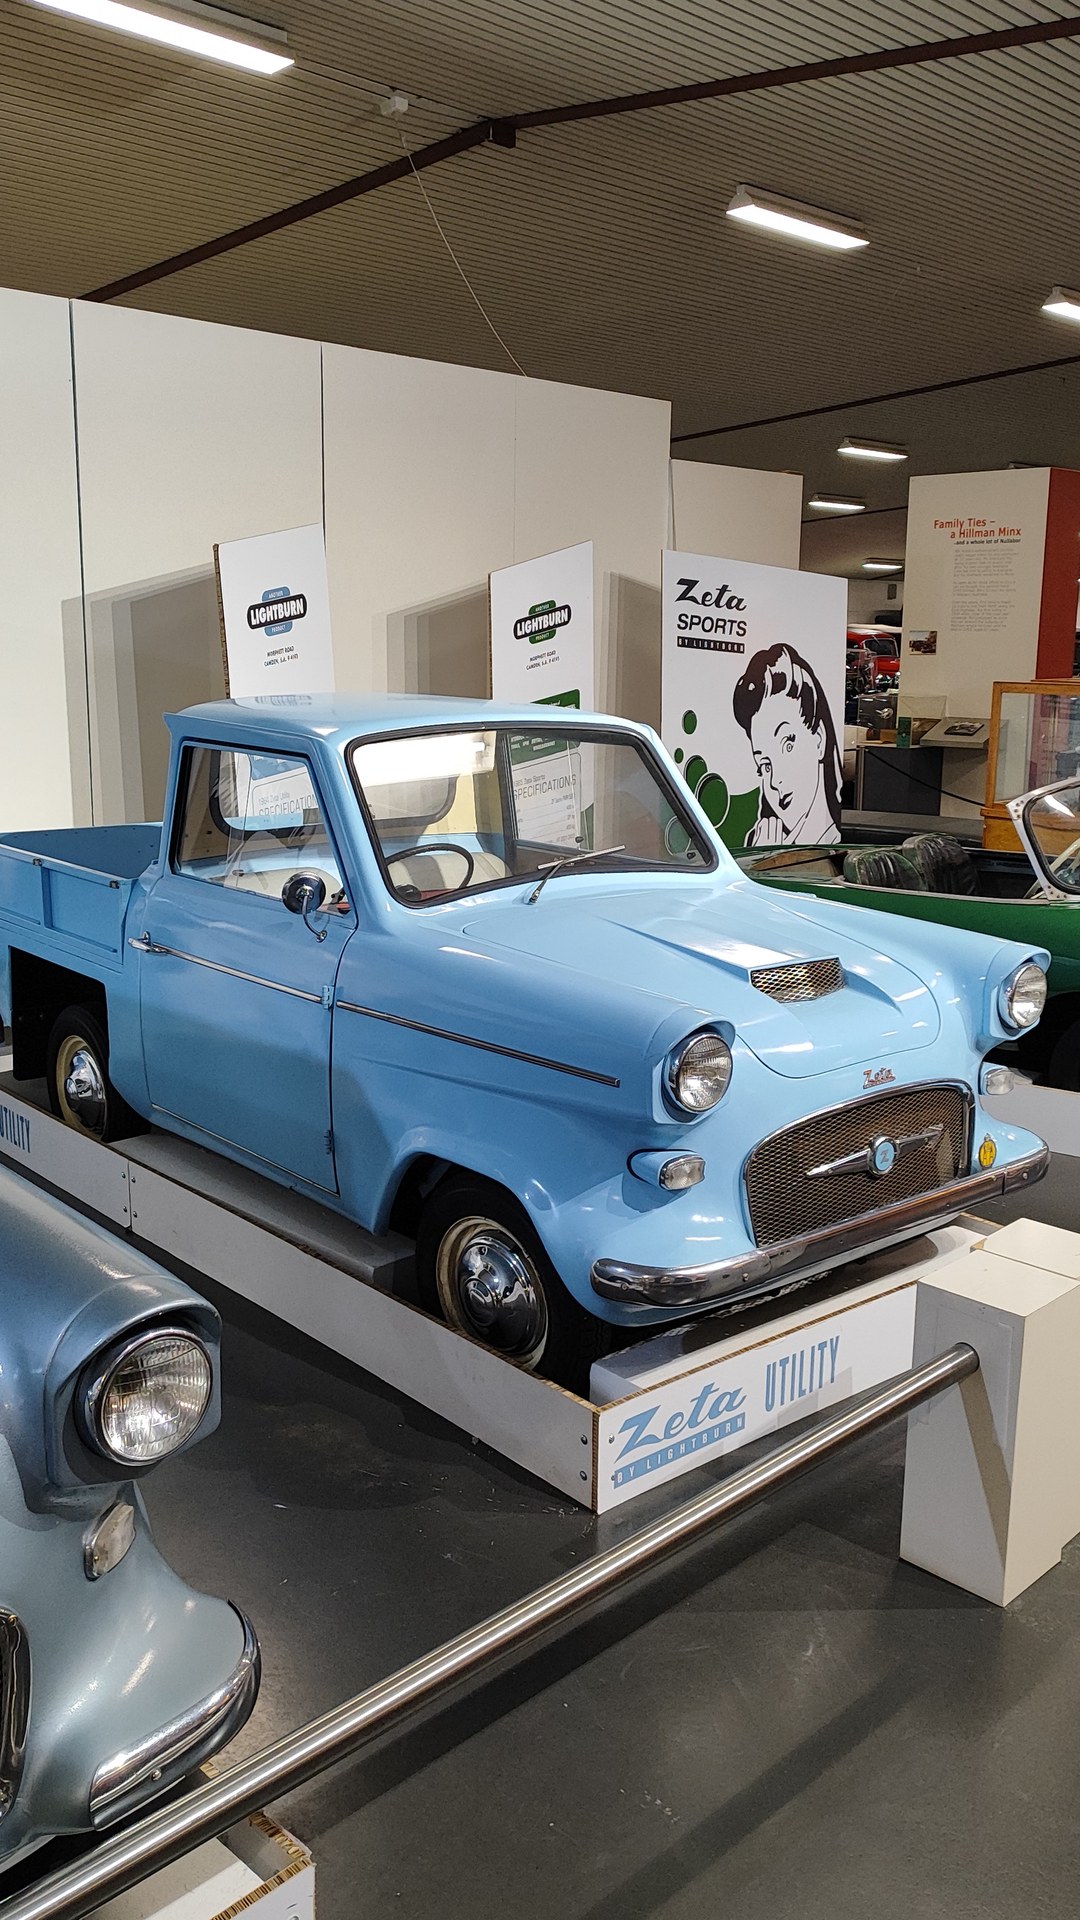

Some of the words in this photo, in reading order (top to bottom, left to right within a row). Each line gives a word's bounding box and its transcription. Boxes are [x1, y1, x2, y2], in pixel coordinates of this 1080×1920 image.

[934, 519, 964, 531] Family
[968, 518, 986, 527] Ties
[958, 528, 994, 538] Hillman
[998, 527, 1022, 536] Minx
[674, 578, 748, 611] Zeta
[250, 598, 304, 626] LIGHTBURN
[516, 608, 568, 636] LIGHTBURN
[677, 613, 747, 637] SPORTS
[863, 1067, 896, 1090] Zeta
[613, 1382, 747, 1464] Zeta
[766, 1335, 840, 1412] UTILITY
[616, 1466, 635, 1484] BY
[646, 1416, 743, 1470] LIGHTBURN
